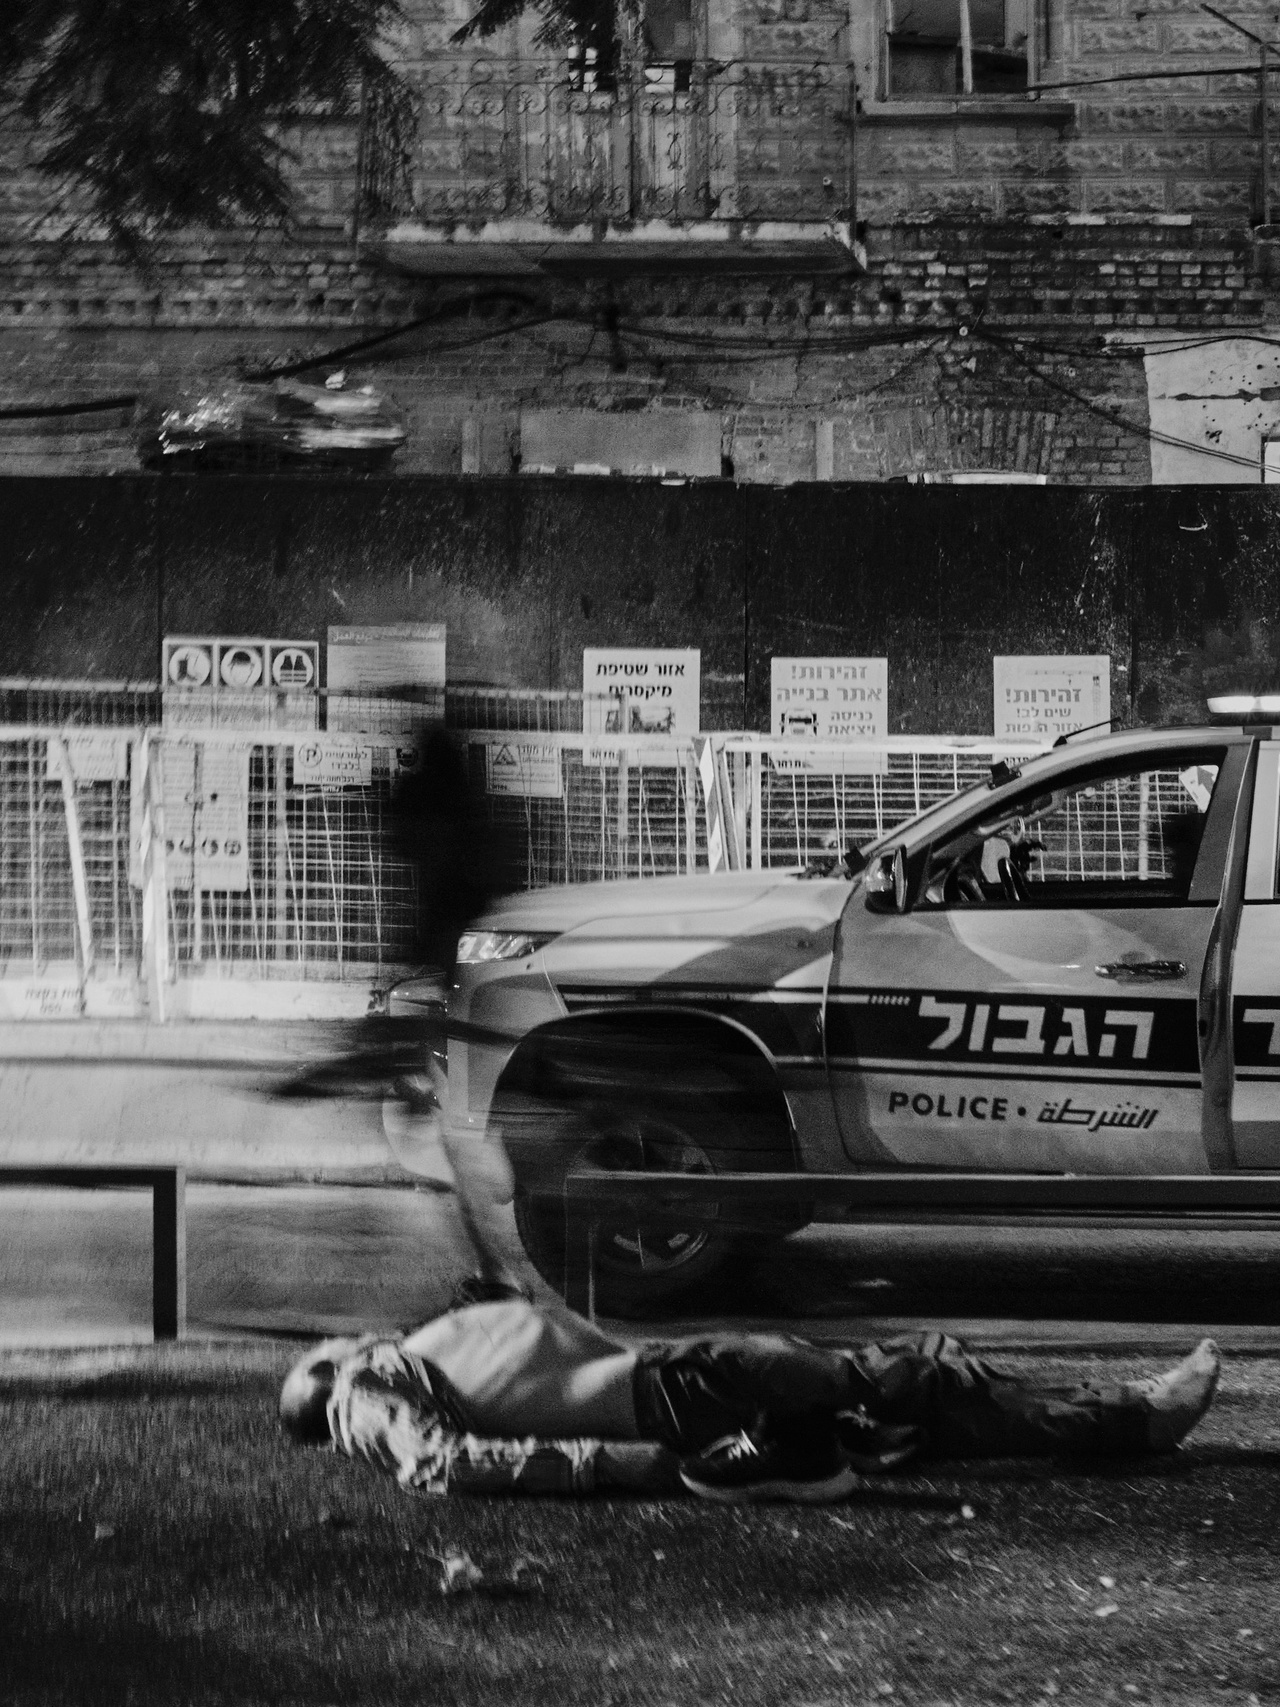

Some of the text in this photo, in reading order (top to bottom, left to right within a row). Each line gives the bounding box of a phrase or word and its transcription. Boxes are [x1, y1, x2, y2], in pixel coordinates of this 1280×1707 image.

[596, 664, 685, 676] אזור שטיפת
[792, 665, 867, 680] זהירות!
[609, 686, 672, 700] מיקסרים
[777, 688, 882, 702] אתר בנייה
[1006, 688, 1082, 702] זהירות!
[831, 712, 873, 721] כניסה
[1016, 706, 1072, 718] שים לב!
[828, 725, 876, 735] ויציאת
[1052, 722, 1083, 732] אזור
[918, 996, 1154, 1059] הגבול
[889, 1091, 1008, 1121] POLICE
[1038, 1098, 1158, 1132] الشرطة
